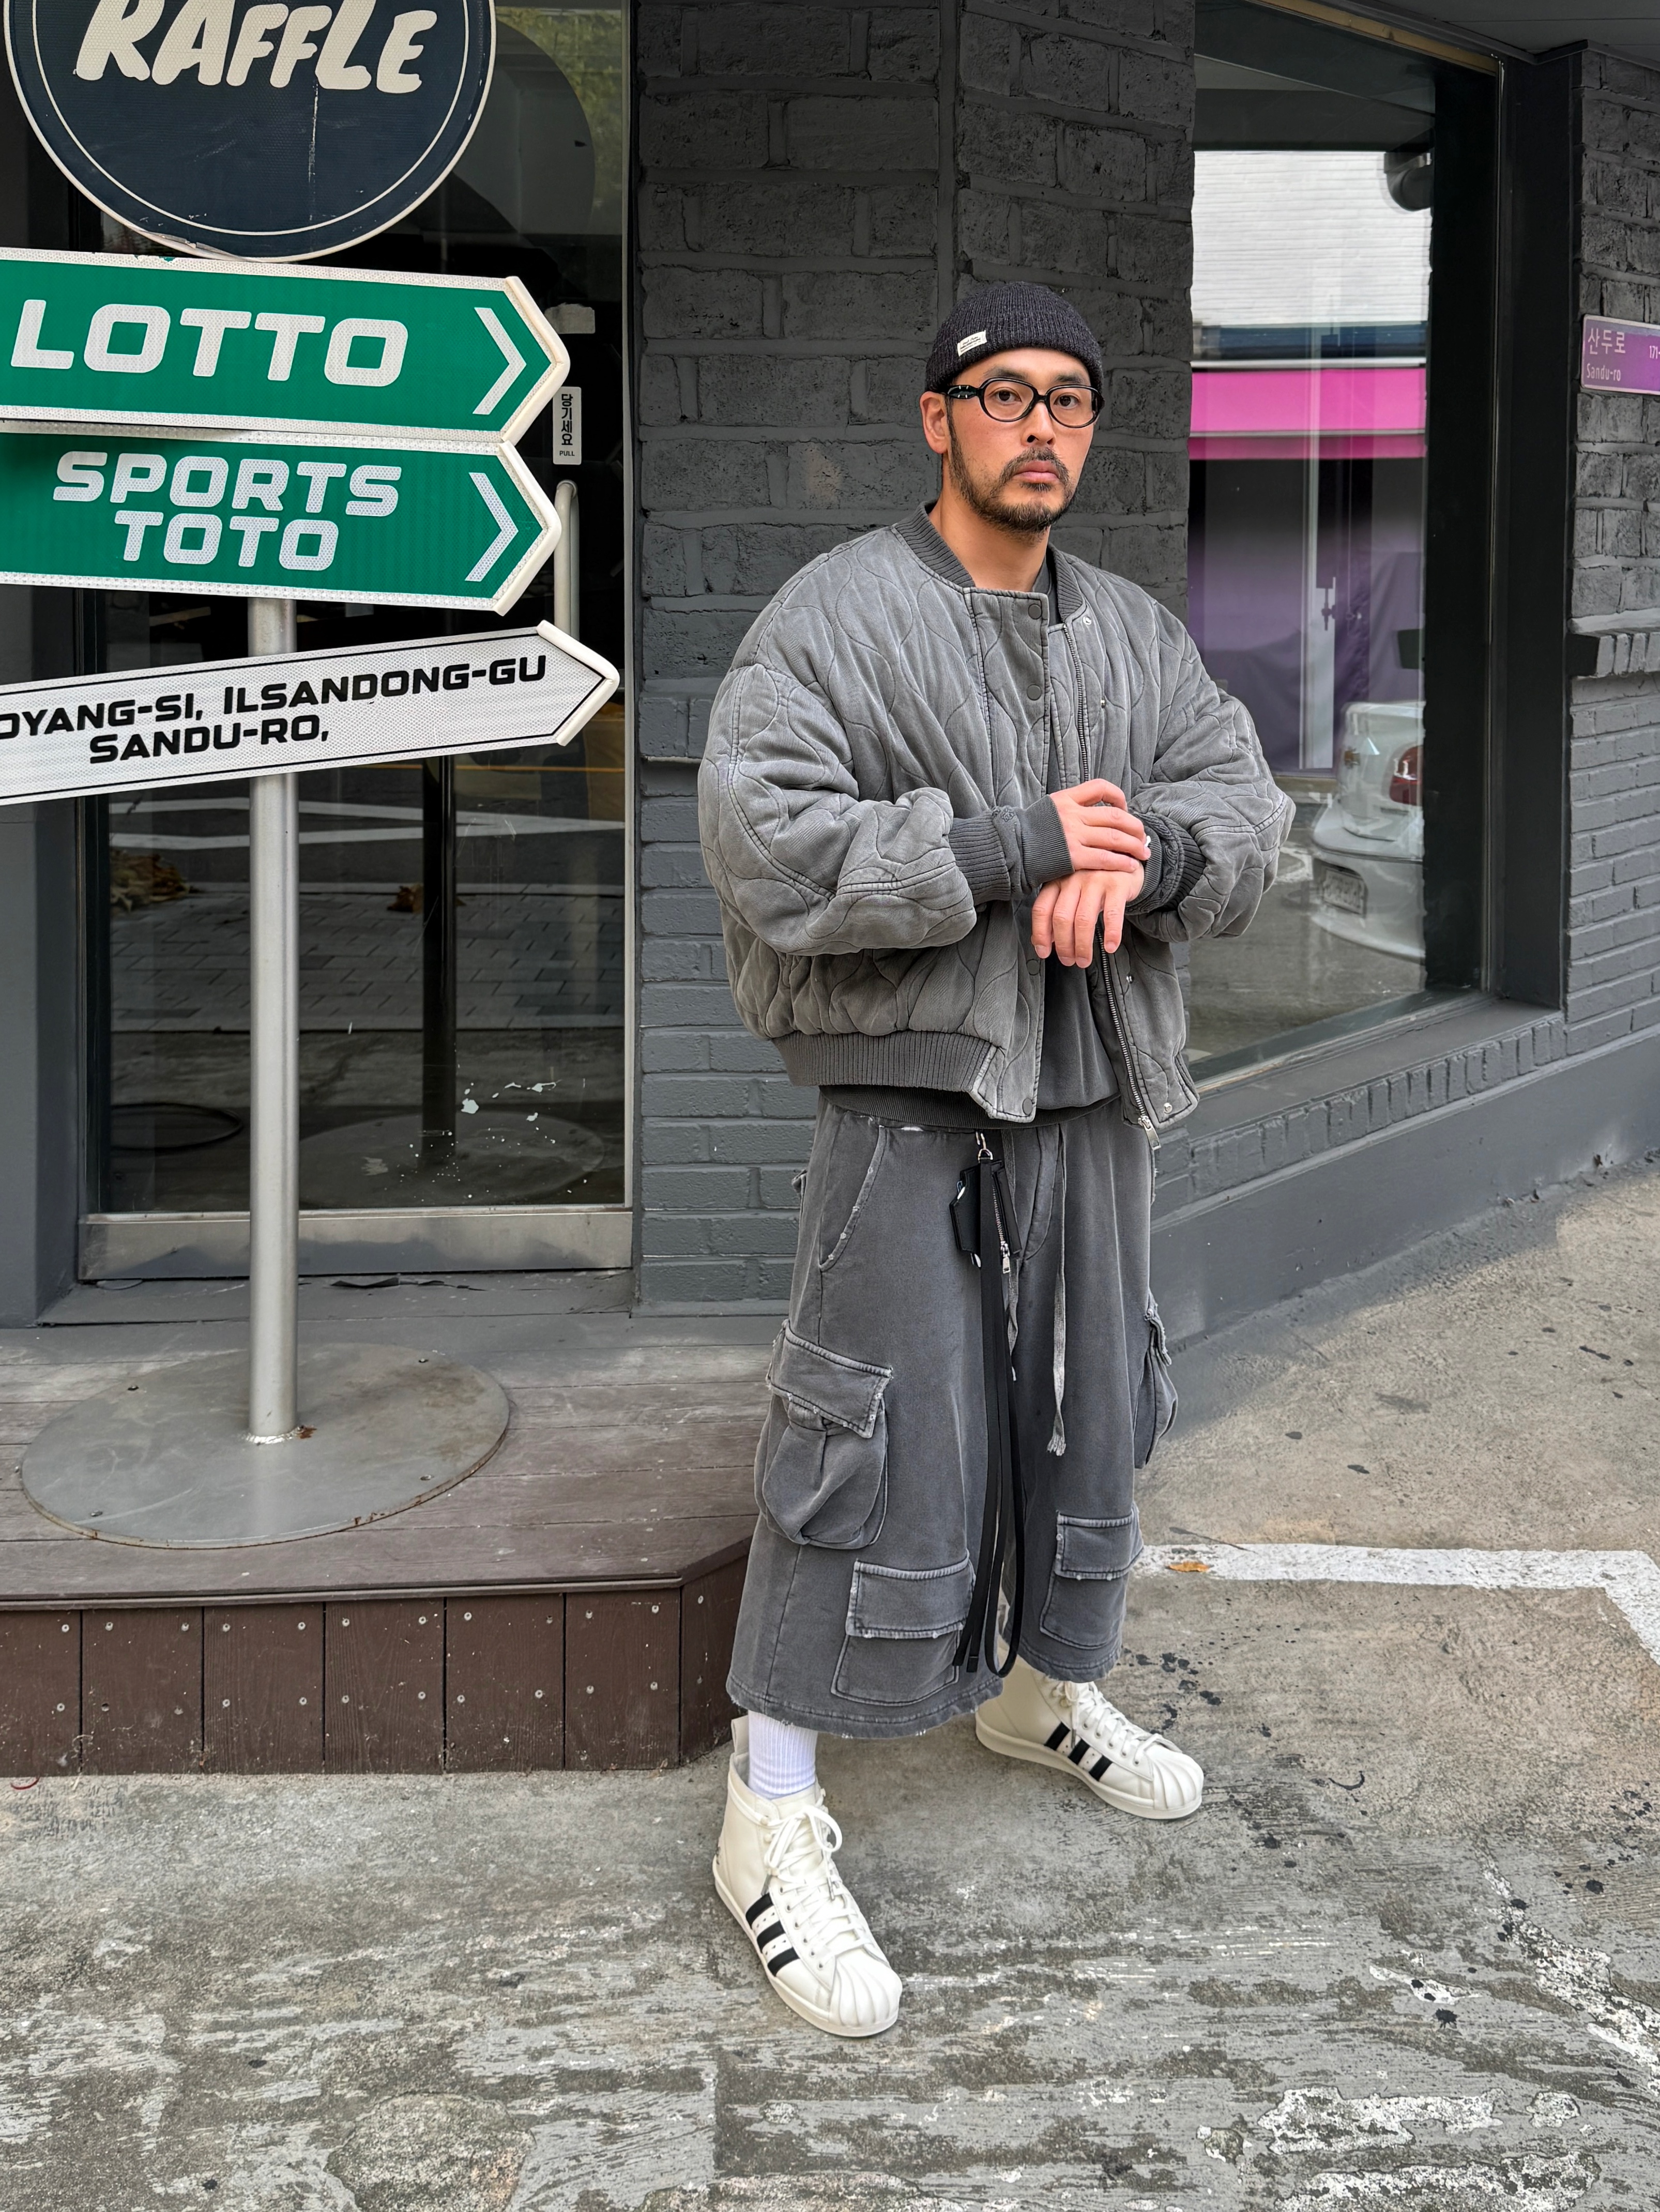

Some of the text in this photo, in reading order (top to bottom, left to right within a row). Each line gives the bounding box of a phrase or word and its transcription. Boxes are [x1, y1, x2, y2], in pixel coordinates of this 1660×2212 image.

[73, 0, 437, 94] RAFFLE
[11, 299, 408, 387] LOTTO
[1588, 328, 1626, 355] 산두로
[1587, 363, 1621, 381] Sandu-ro
[561, 394, 573, 446] 당기세요
[53, 451, 402, 517] SPORTS
[115, 510, 339, 571] TOTO
[224, 655, 546, 715] ILSANDONG-GU
[89, 714, 329, 764] SANDU-RO,
